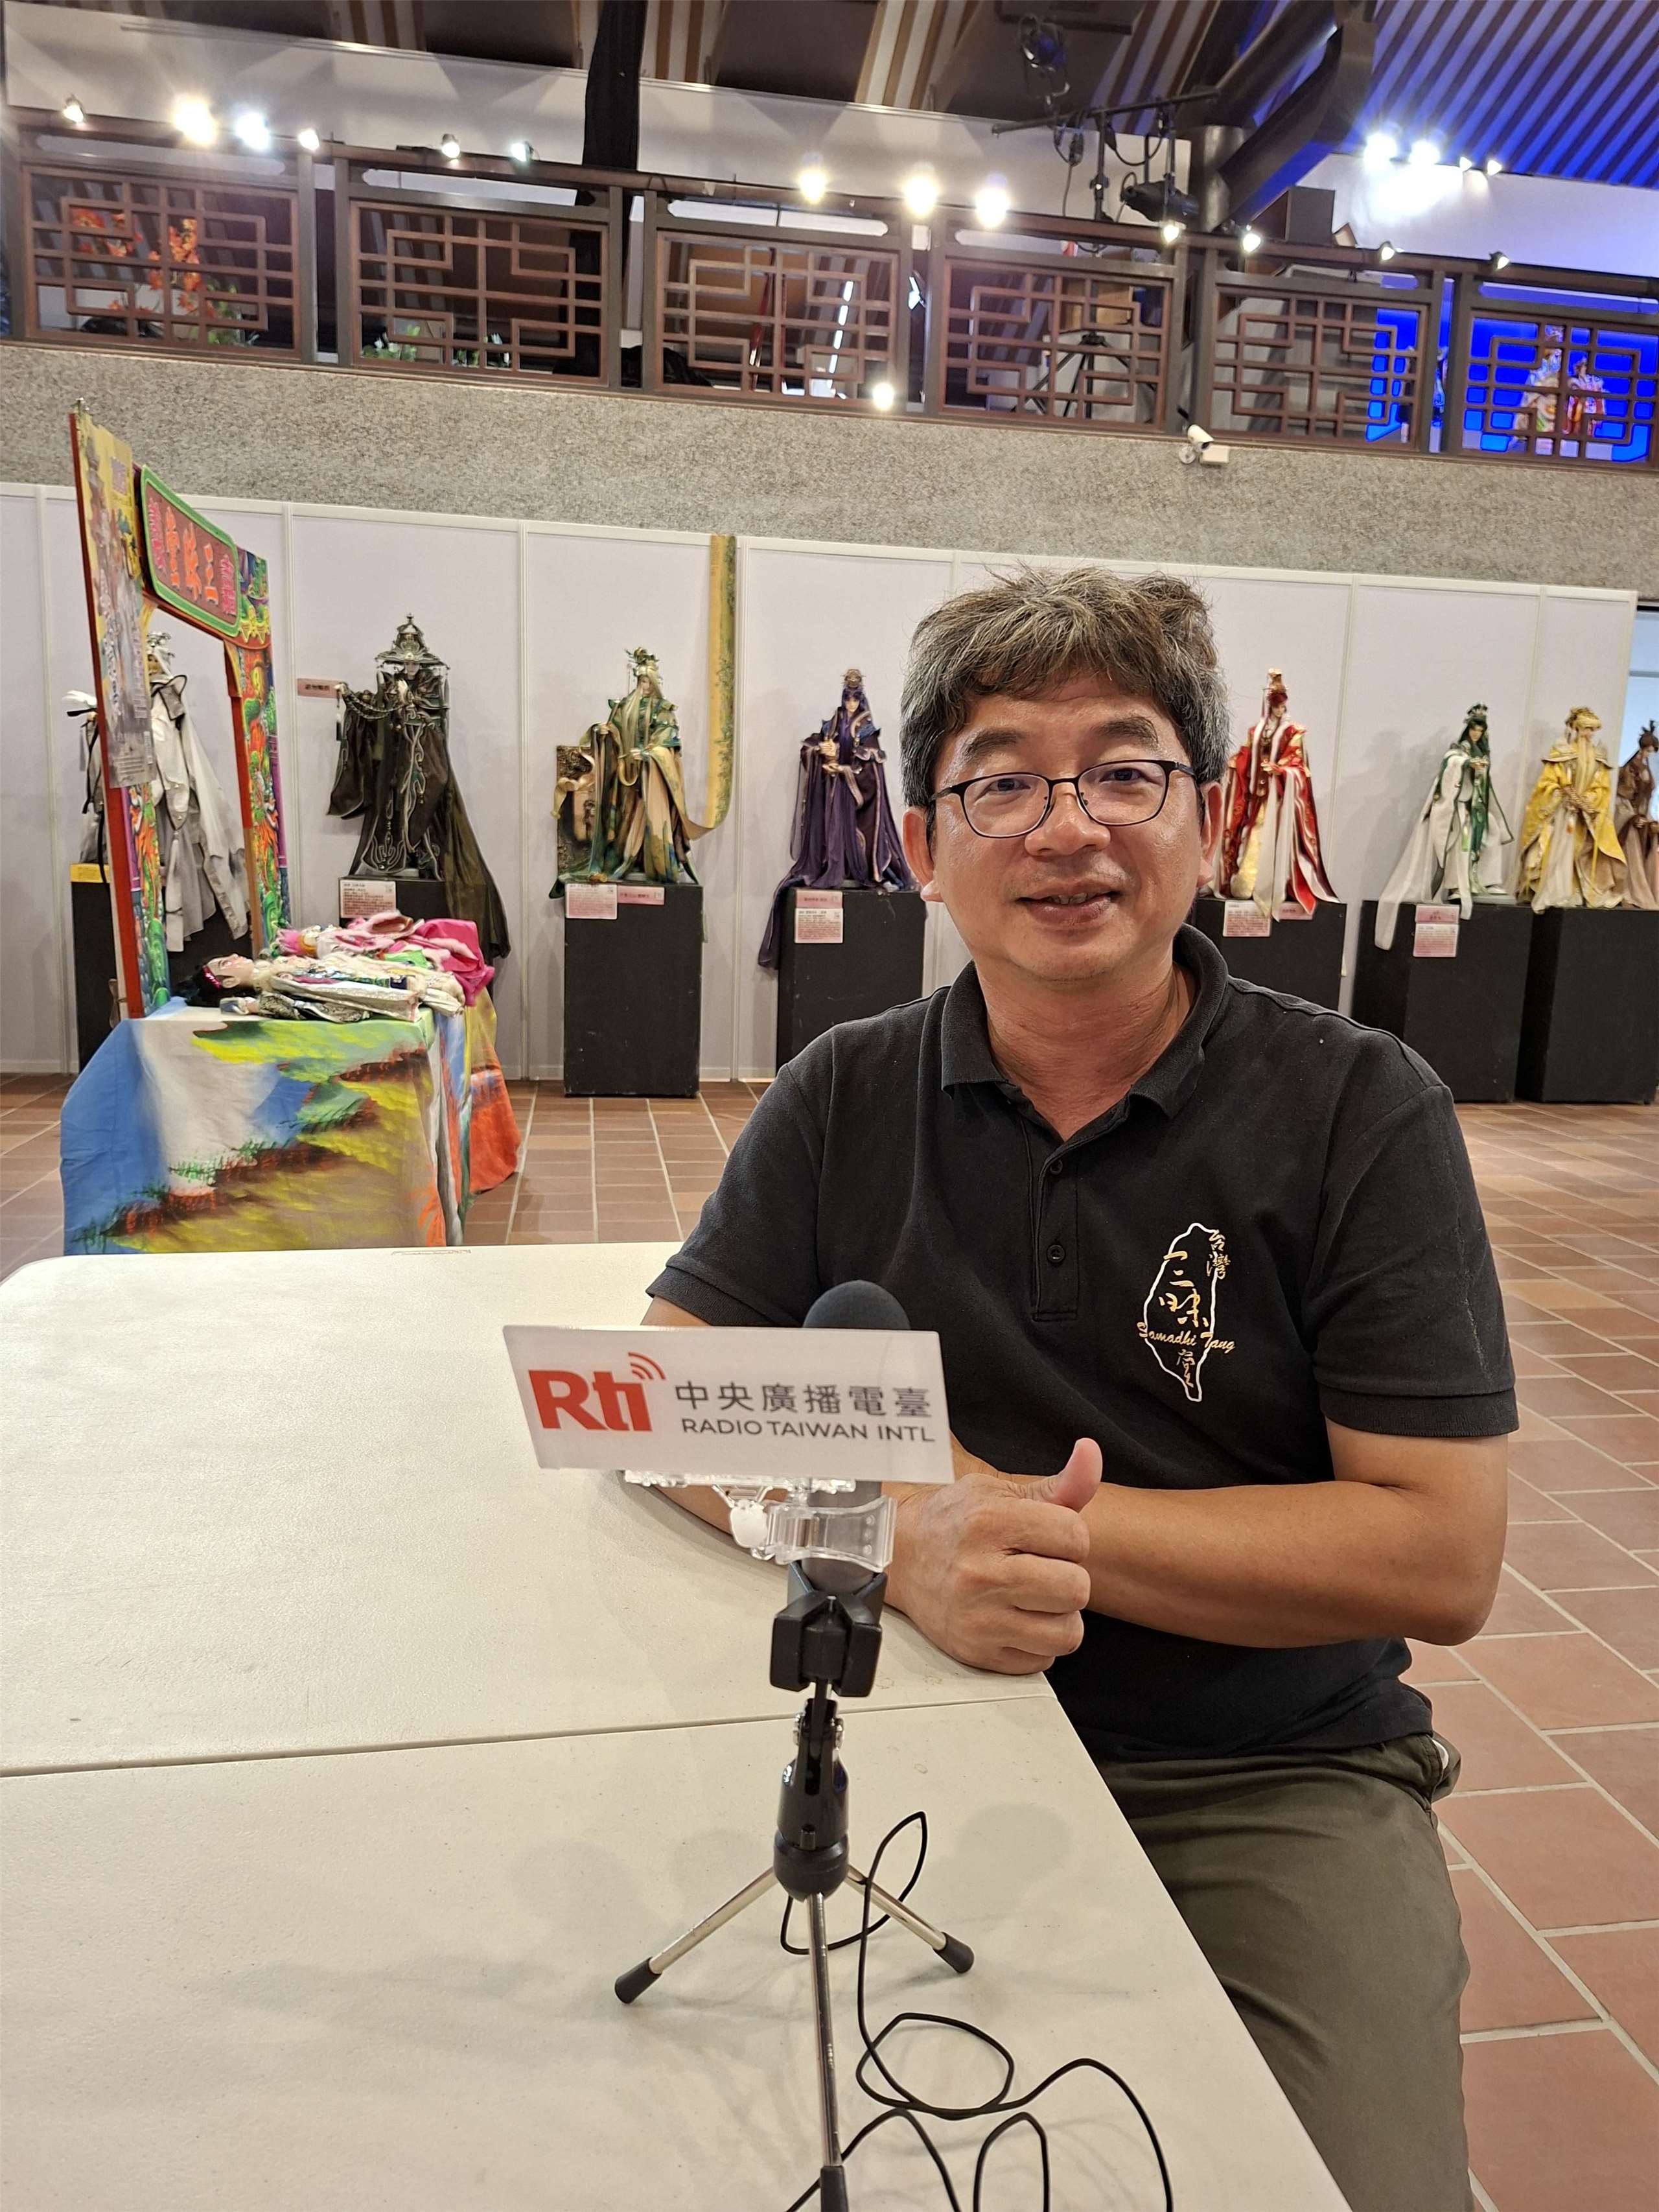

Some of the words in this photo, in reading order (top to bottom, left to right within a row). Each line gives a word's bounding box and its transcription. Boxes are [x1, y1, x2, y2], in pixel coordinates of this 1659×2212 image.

[1137, 1321, 1197, 1346] Samadhi
[1200, 1331, 1235, 1353] Tang
[675, 1380, 932, 1417] 中央廣播電臺
[681, 1418, 762, 1435] RADIO
[767, 1420, 868, 1439] TAIWAN
[878, 1425, 935, 1442] INTL
